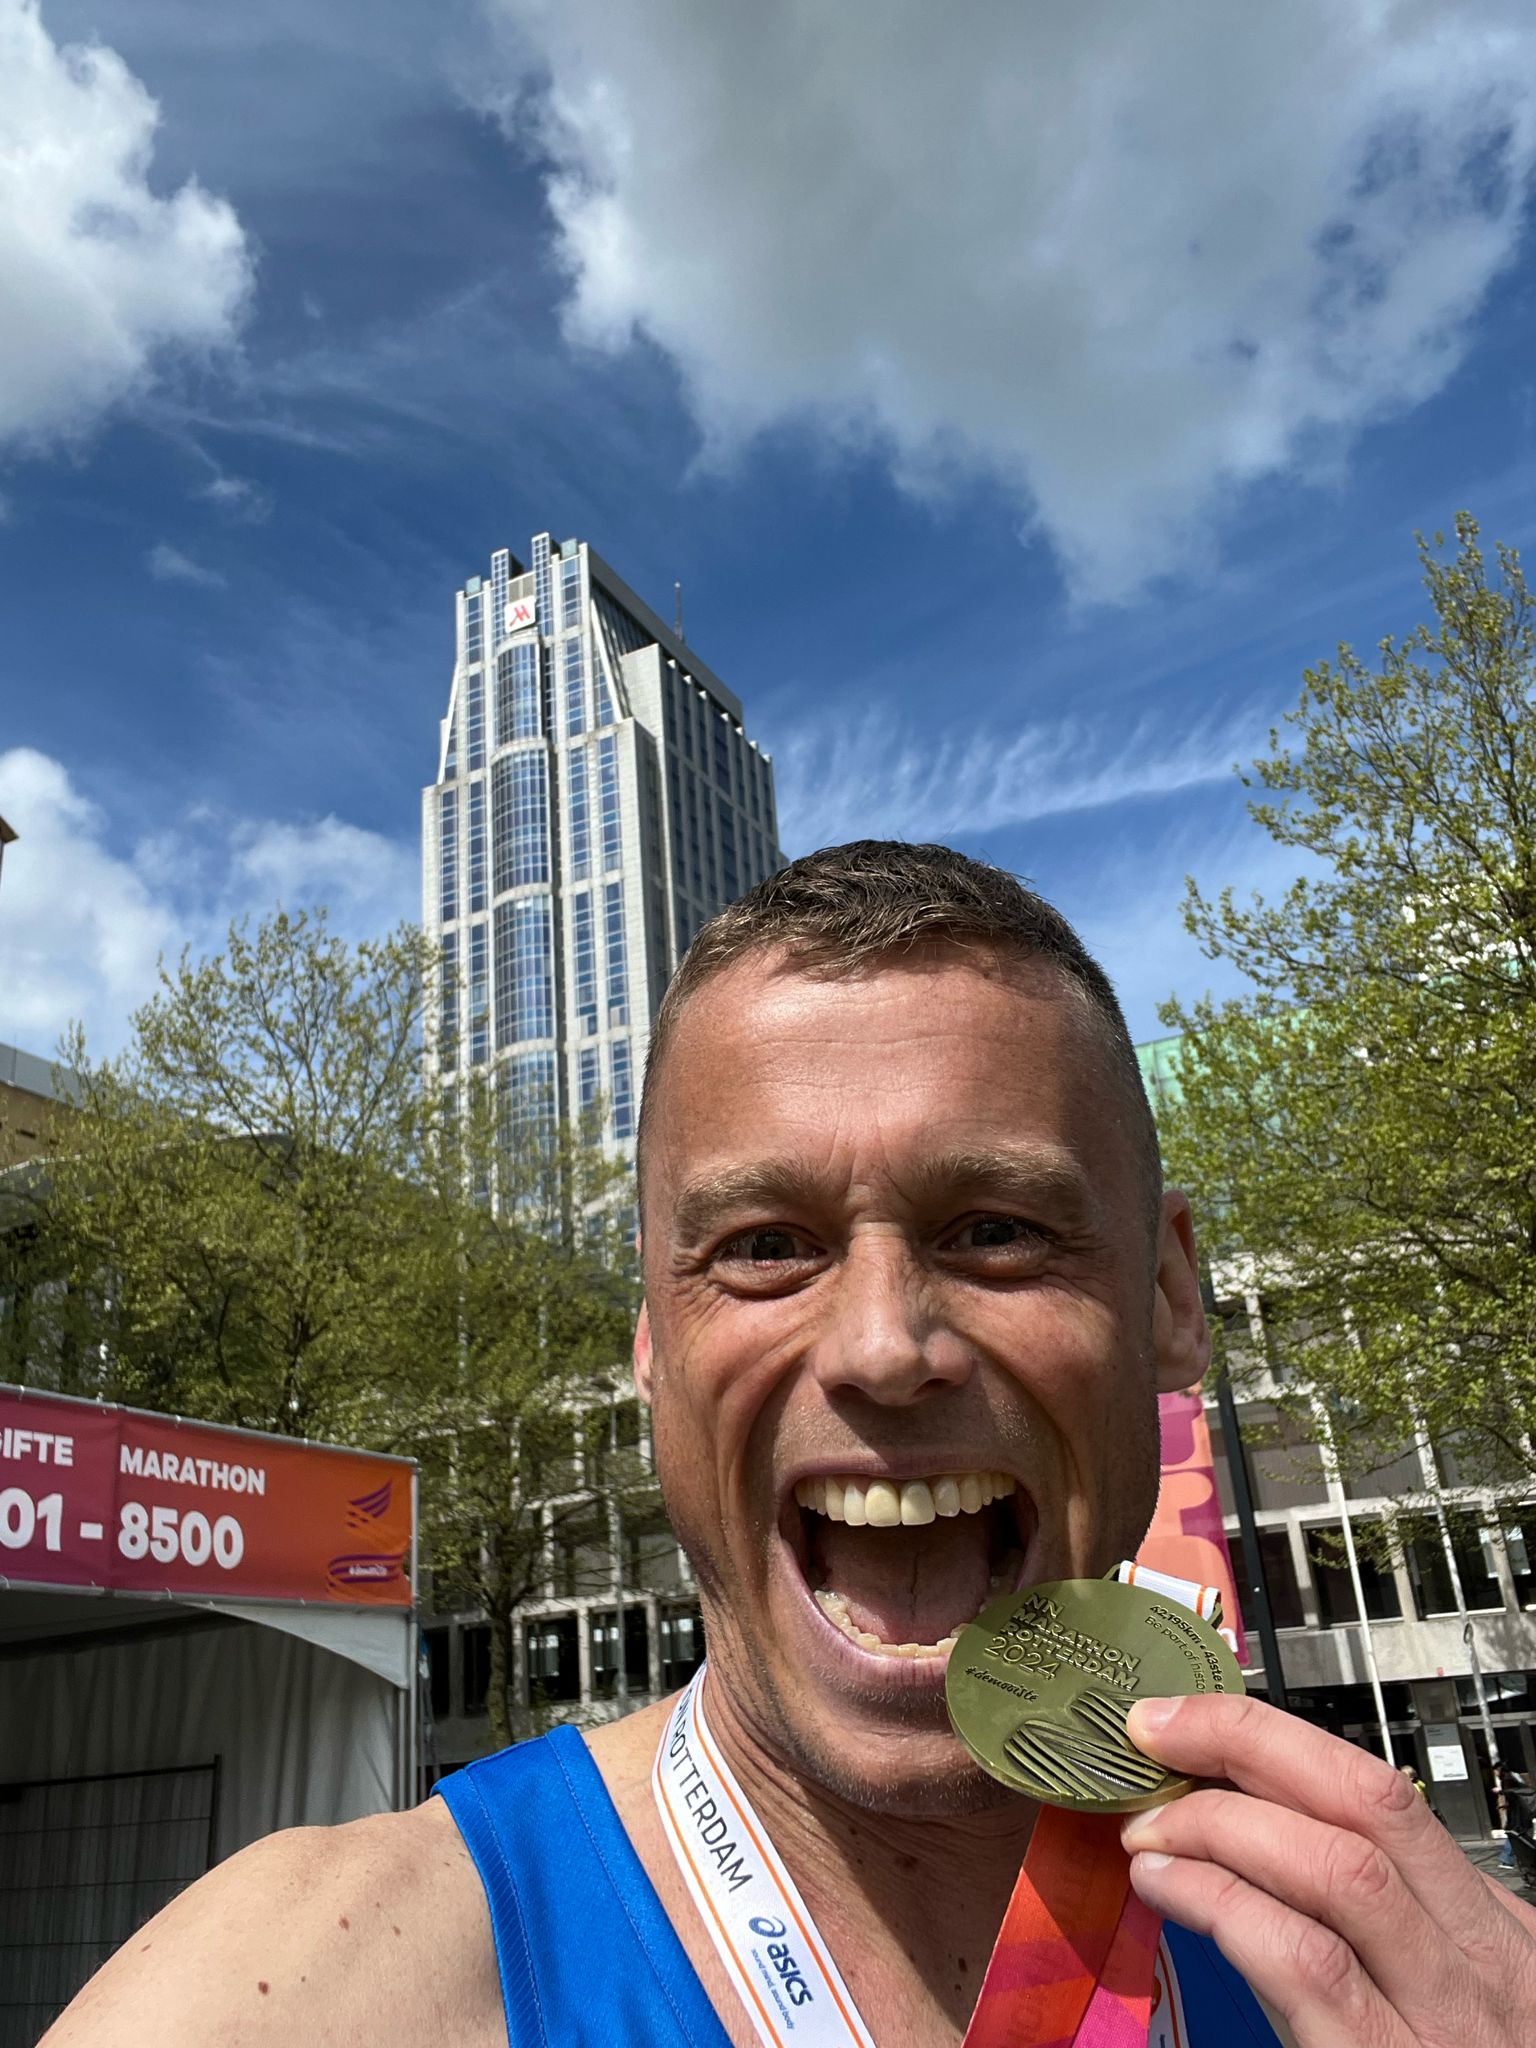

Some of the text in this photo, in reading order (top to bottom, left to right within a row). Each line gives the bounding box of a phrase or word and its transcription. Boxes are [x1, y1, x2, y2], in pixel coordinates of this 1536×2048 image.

[0, 1427, 74, 1467] IFTE
[119, 1444, 266, 1496] MARATHON
[117, 1500, 244, 1570] 8500
[1024, 1593, 1065, 1618] NN
[984, 1636, 1062, 1680] 2024
[1000, 1622, 1140, 1692] ROTTERDAM
[1012, 1608, 1141, 1672] MARATHON
[1144, 1616, 1162, 1630] Be
[1161, 1627, 1188, 1650] part
[1183, 1649, 1200, 1663] of
[1149, 1604, 1203, 1644] 42,195km
[1204, 1649, 1223, 1682] 43ste
[964, 1665, 1039, 1704] #demooiste
[669, 1719, 754, 1893] ROTTERDAM
[766, 1942, 815, 2008] asics
